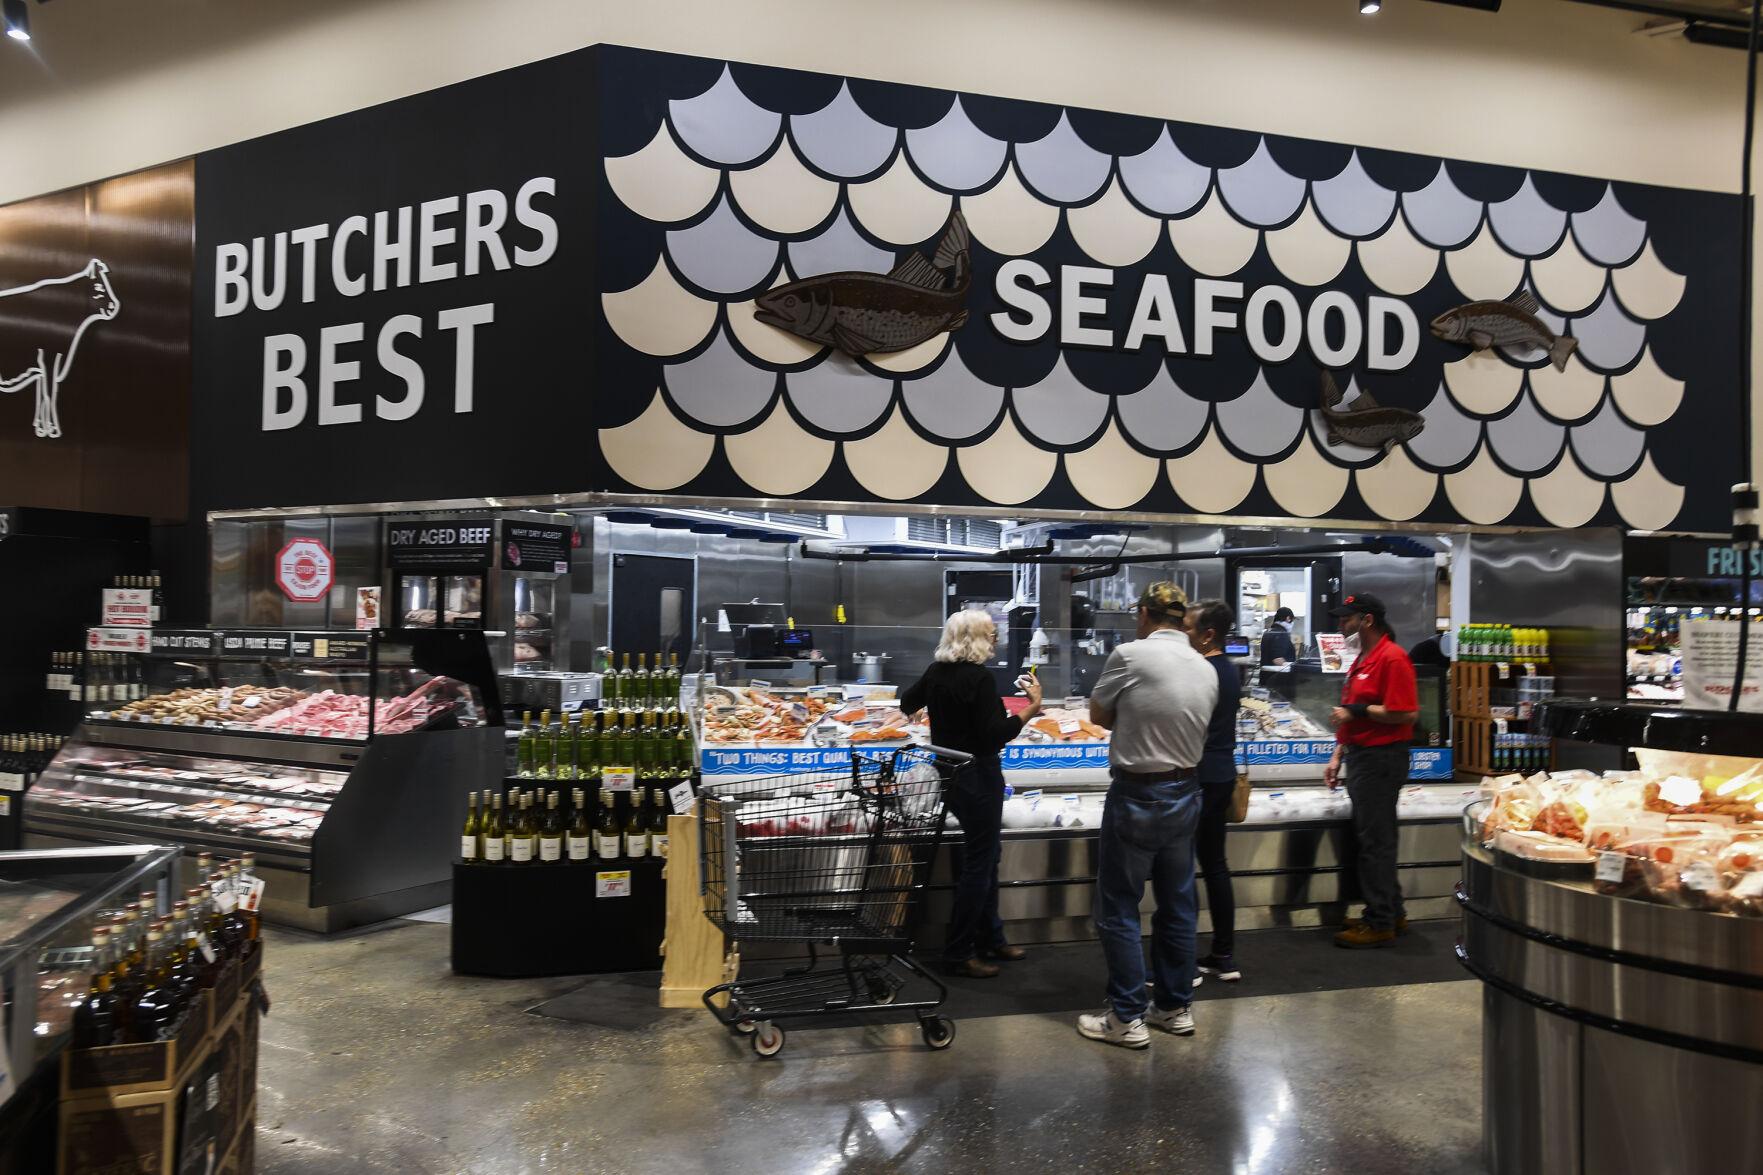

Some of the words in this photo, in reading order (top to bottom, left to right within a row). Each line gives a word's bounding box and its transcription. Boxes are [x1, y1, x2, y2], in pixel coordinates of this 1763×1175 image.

[215, 177, 559, 317] BUTCHERS
[989, 258, 1421, 372] SEAFOOD
[262, 303, 494, 431] BEST
[391, 529, 416, 545] DRY
[418, 528, 456, 545] AGED
[459, 527, 492, 544] BEEF
[792, 751, 821, 764] BEST
[1247, 743, 1290, 755] FILLETED
[1292, 743, 1310, 755] FOR
